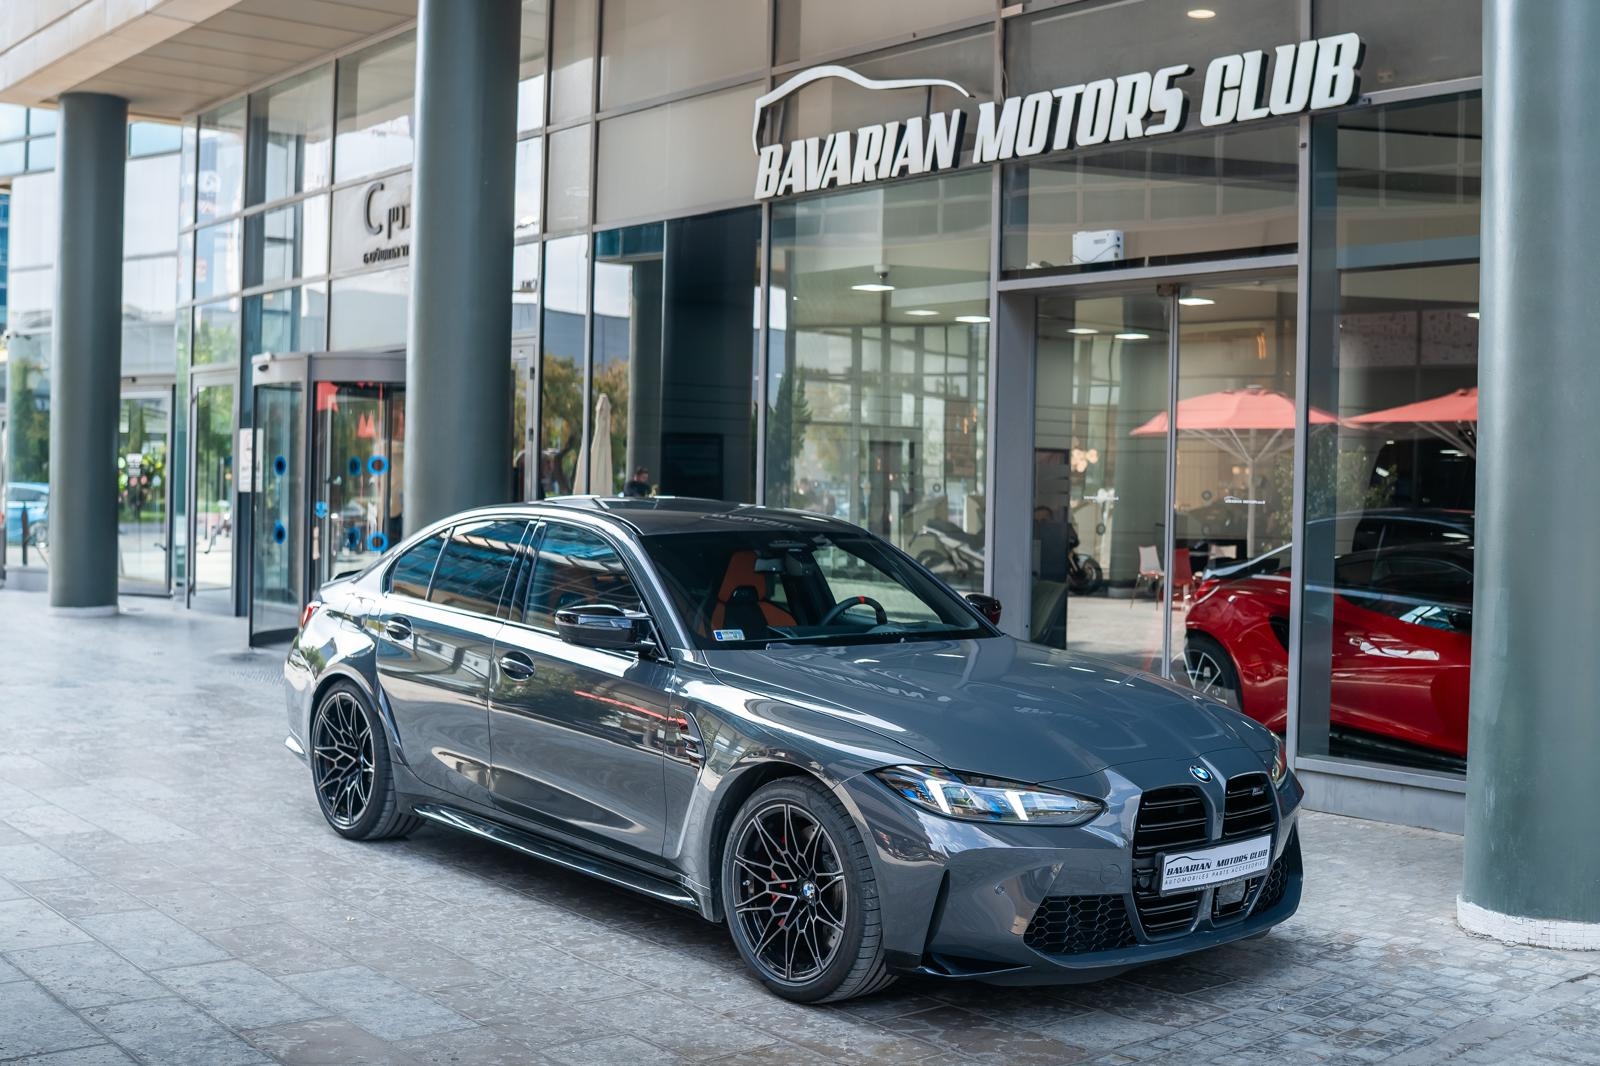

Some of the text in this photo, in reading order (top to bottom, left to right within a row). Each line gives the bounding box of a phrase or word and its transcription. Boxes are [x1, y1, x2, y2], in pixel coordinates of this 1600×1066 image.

[754, 32, 1364, 200] BAVARIAN MOTORS CLUB
[1166, 849, 1268, 876] BAVARIAN MOTORS CLUB
